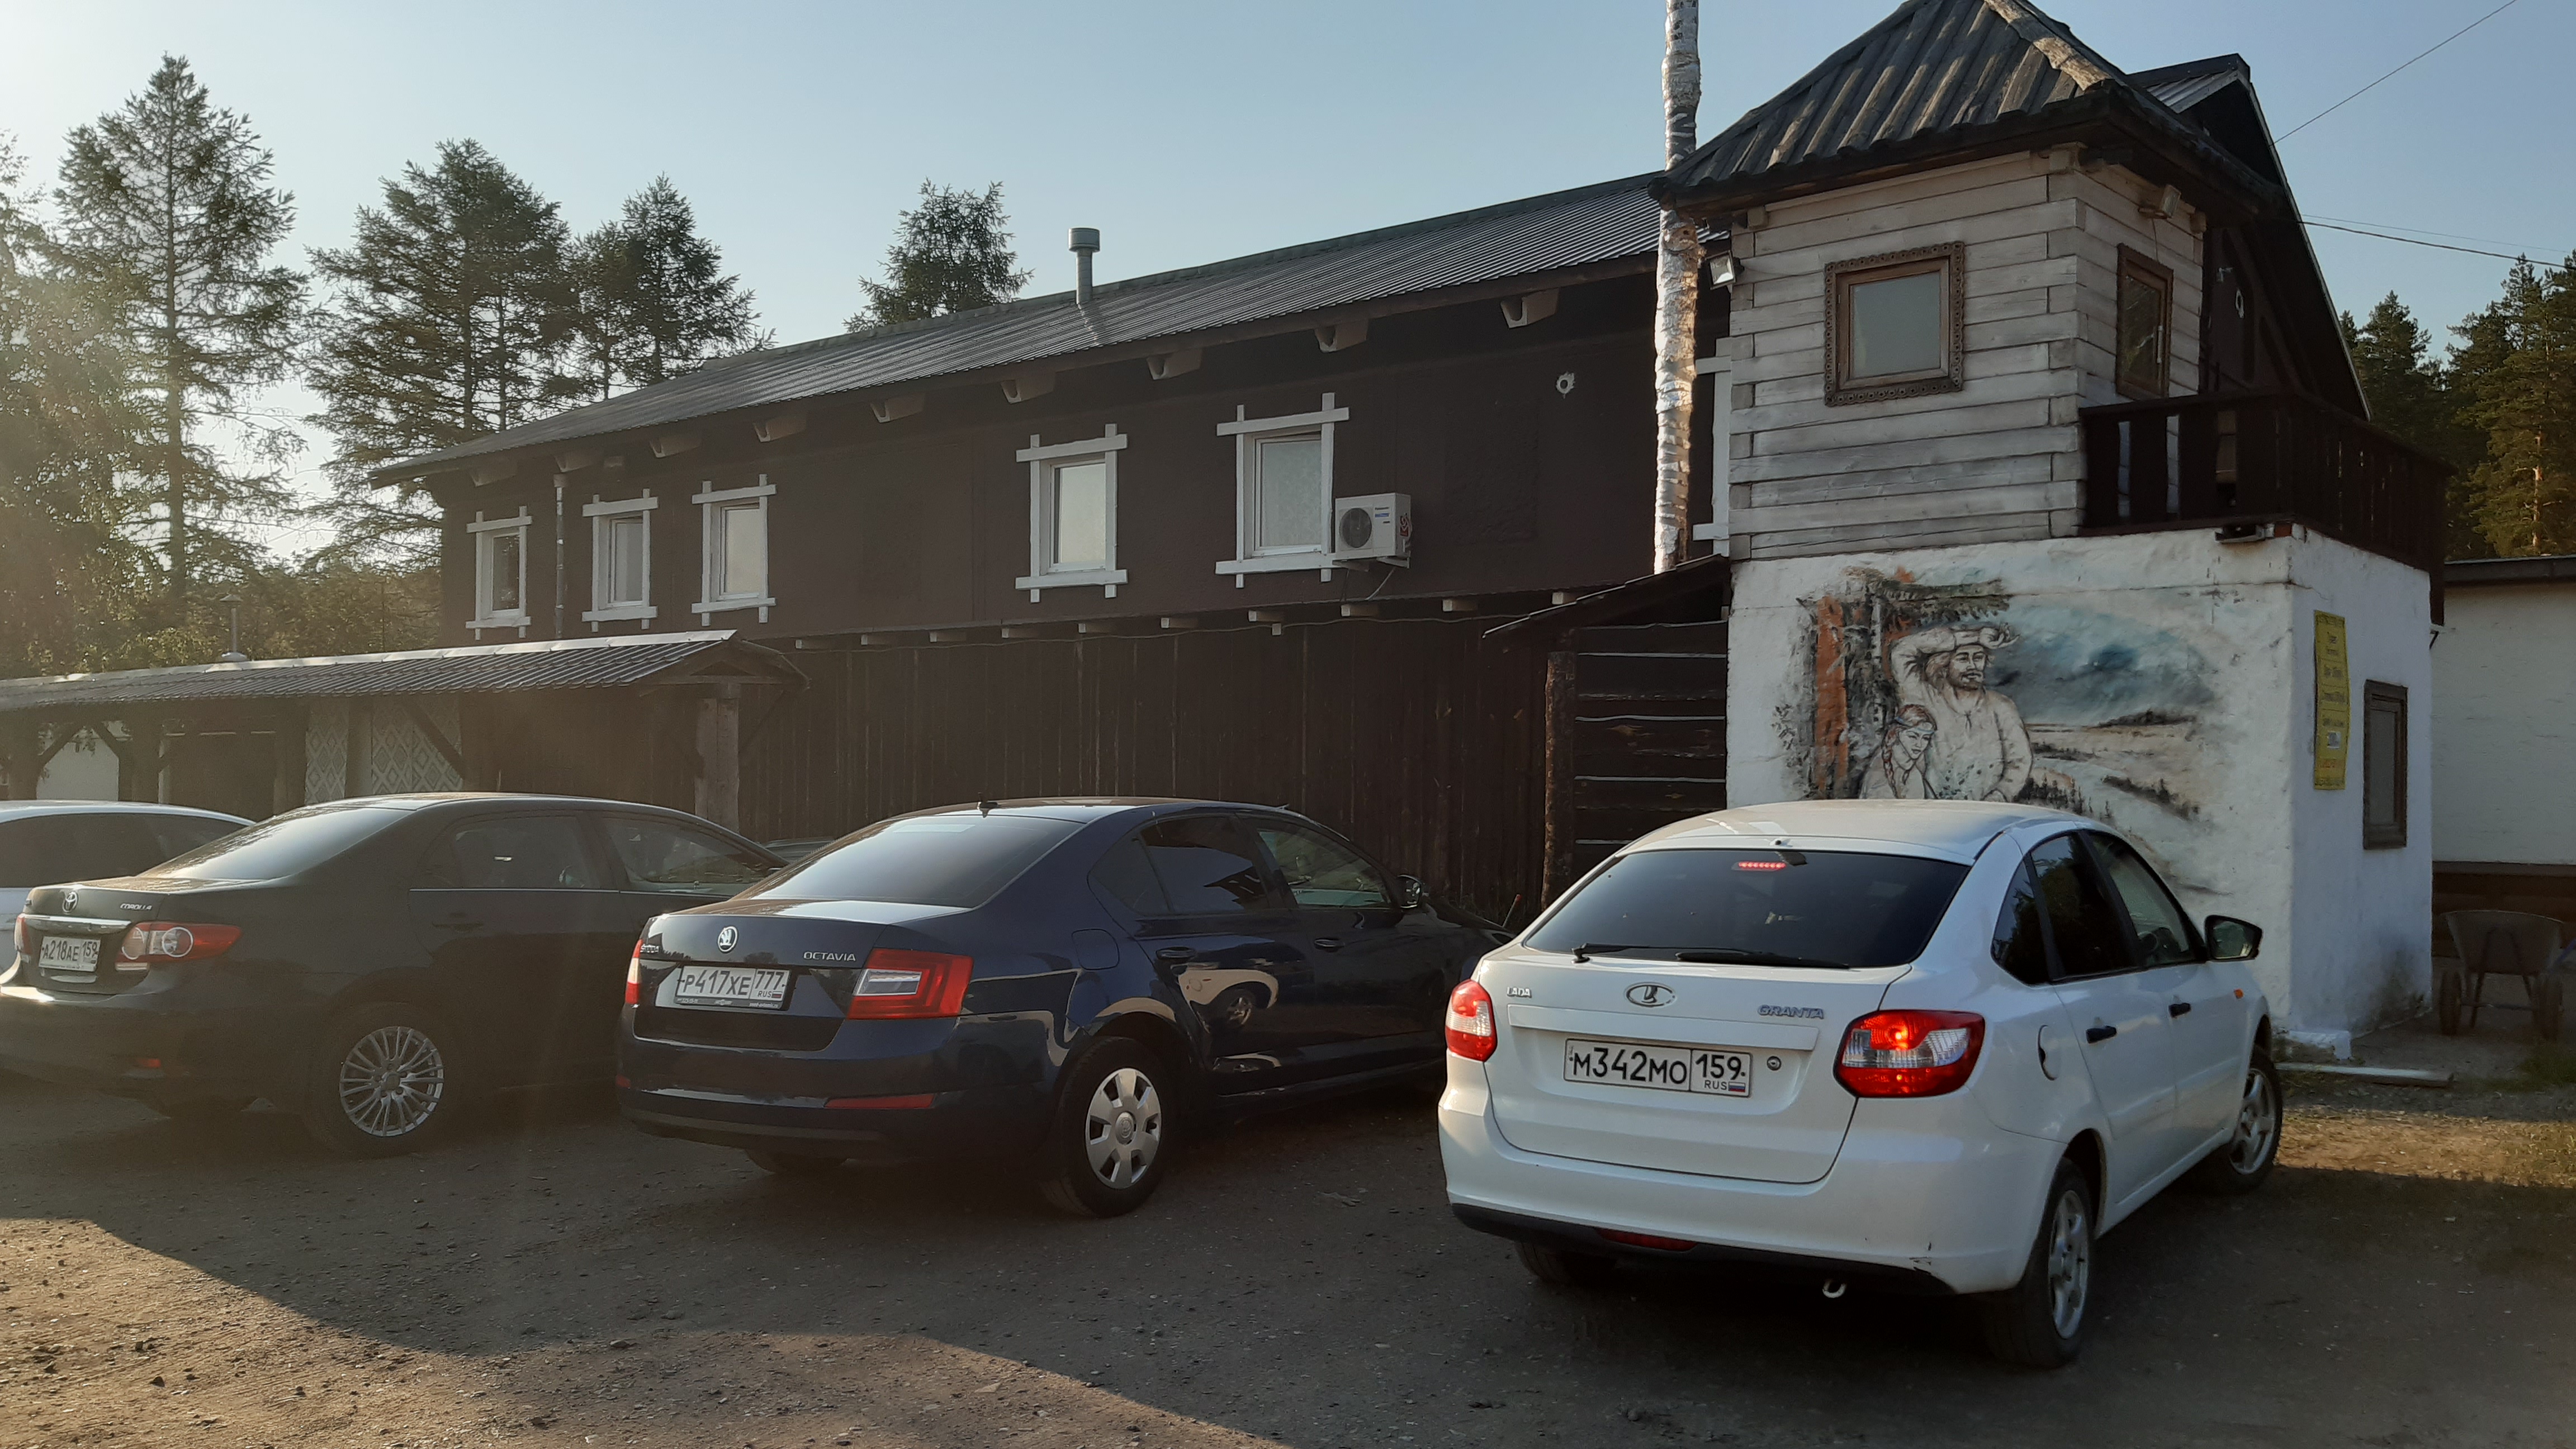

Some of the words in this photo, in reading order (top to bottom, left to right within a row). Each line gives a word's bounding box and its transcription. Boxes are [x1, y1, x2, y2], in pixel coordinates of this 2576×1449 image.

[82, 941, 98, 958] 159
[804, 951, 856, 961] OCTAVIA
[755, 970, 784, 991] 777
[1507, 987, 1532, 998] LADA
[1758, 1005, 1824, 1020] GRANTA
[1695, 1054, 1742, 1081] 159
[1704, 1079, 1727, 1091] RUS
